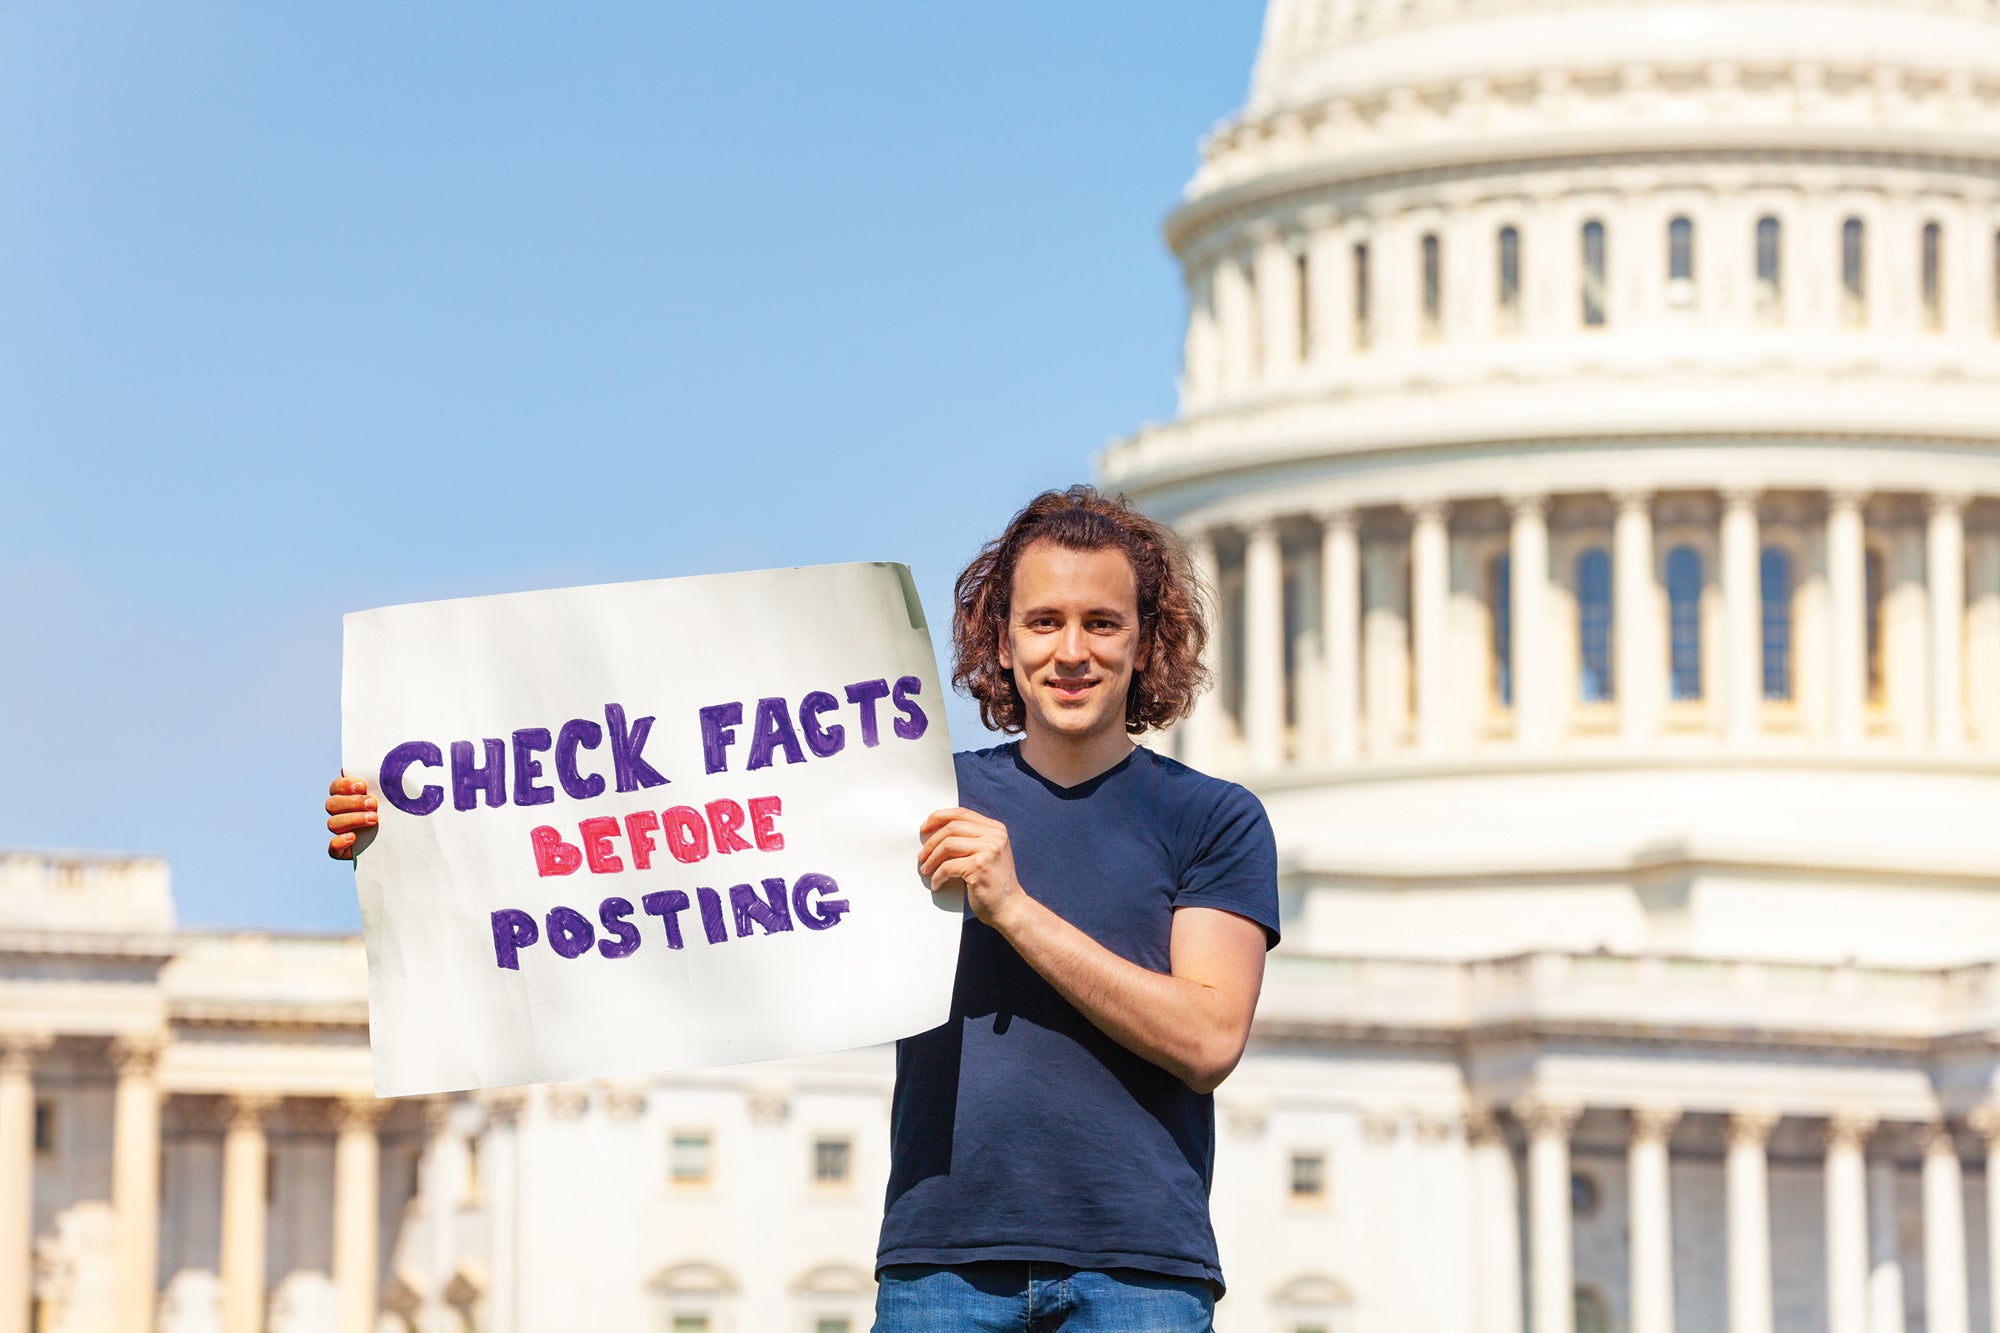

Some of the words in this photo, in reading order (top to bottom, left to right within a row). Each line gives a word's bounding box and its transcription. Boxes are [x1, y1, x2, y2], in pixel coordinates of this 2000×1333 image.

[699, 676, 929, 775] FACTS
[530, 795, 785, 878] BEFORE
[491, 872, 850, 971] POSTING
